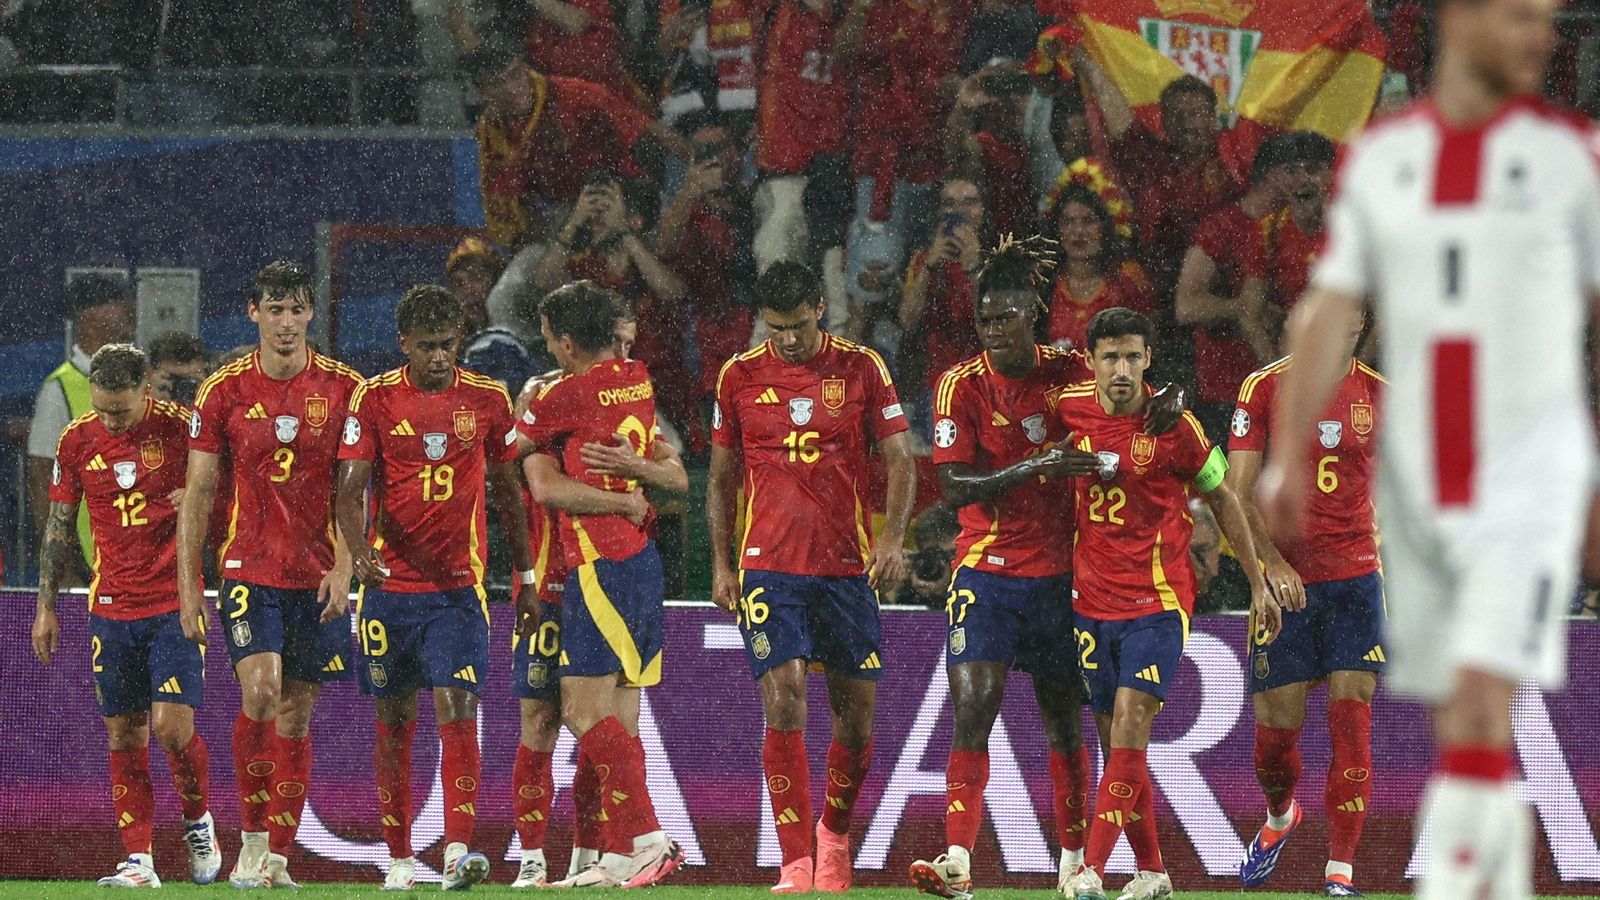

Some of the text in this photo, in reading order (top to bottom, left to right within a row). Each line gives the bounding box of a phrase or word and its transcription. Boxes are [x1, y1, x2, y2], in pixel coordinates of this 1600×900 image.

[270, 447, 295, 483] 3
[783, 431, 820, 464] 16
[418, 464, 455, 502] 19
[1317, 455, 1340, 494] 6
[112, 491, 148, 527] 12
[1089, 484, 1127, 526] 22
[230, 585, 250, 619] 3
[740, 586, 770, 630] 16
[361, 618, 388, 656] 19
